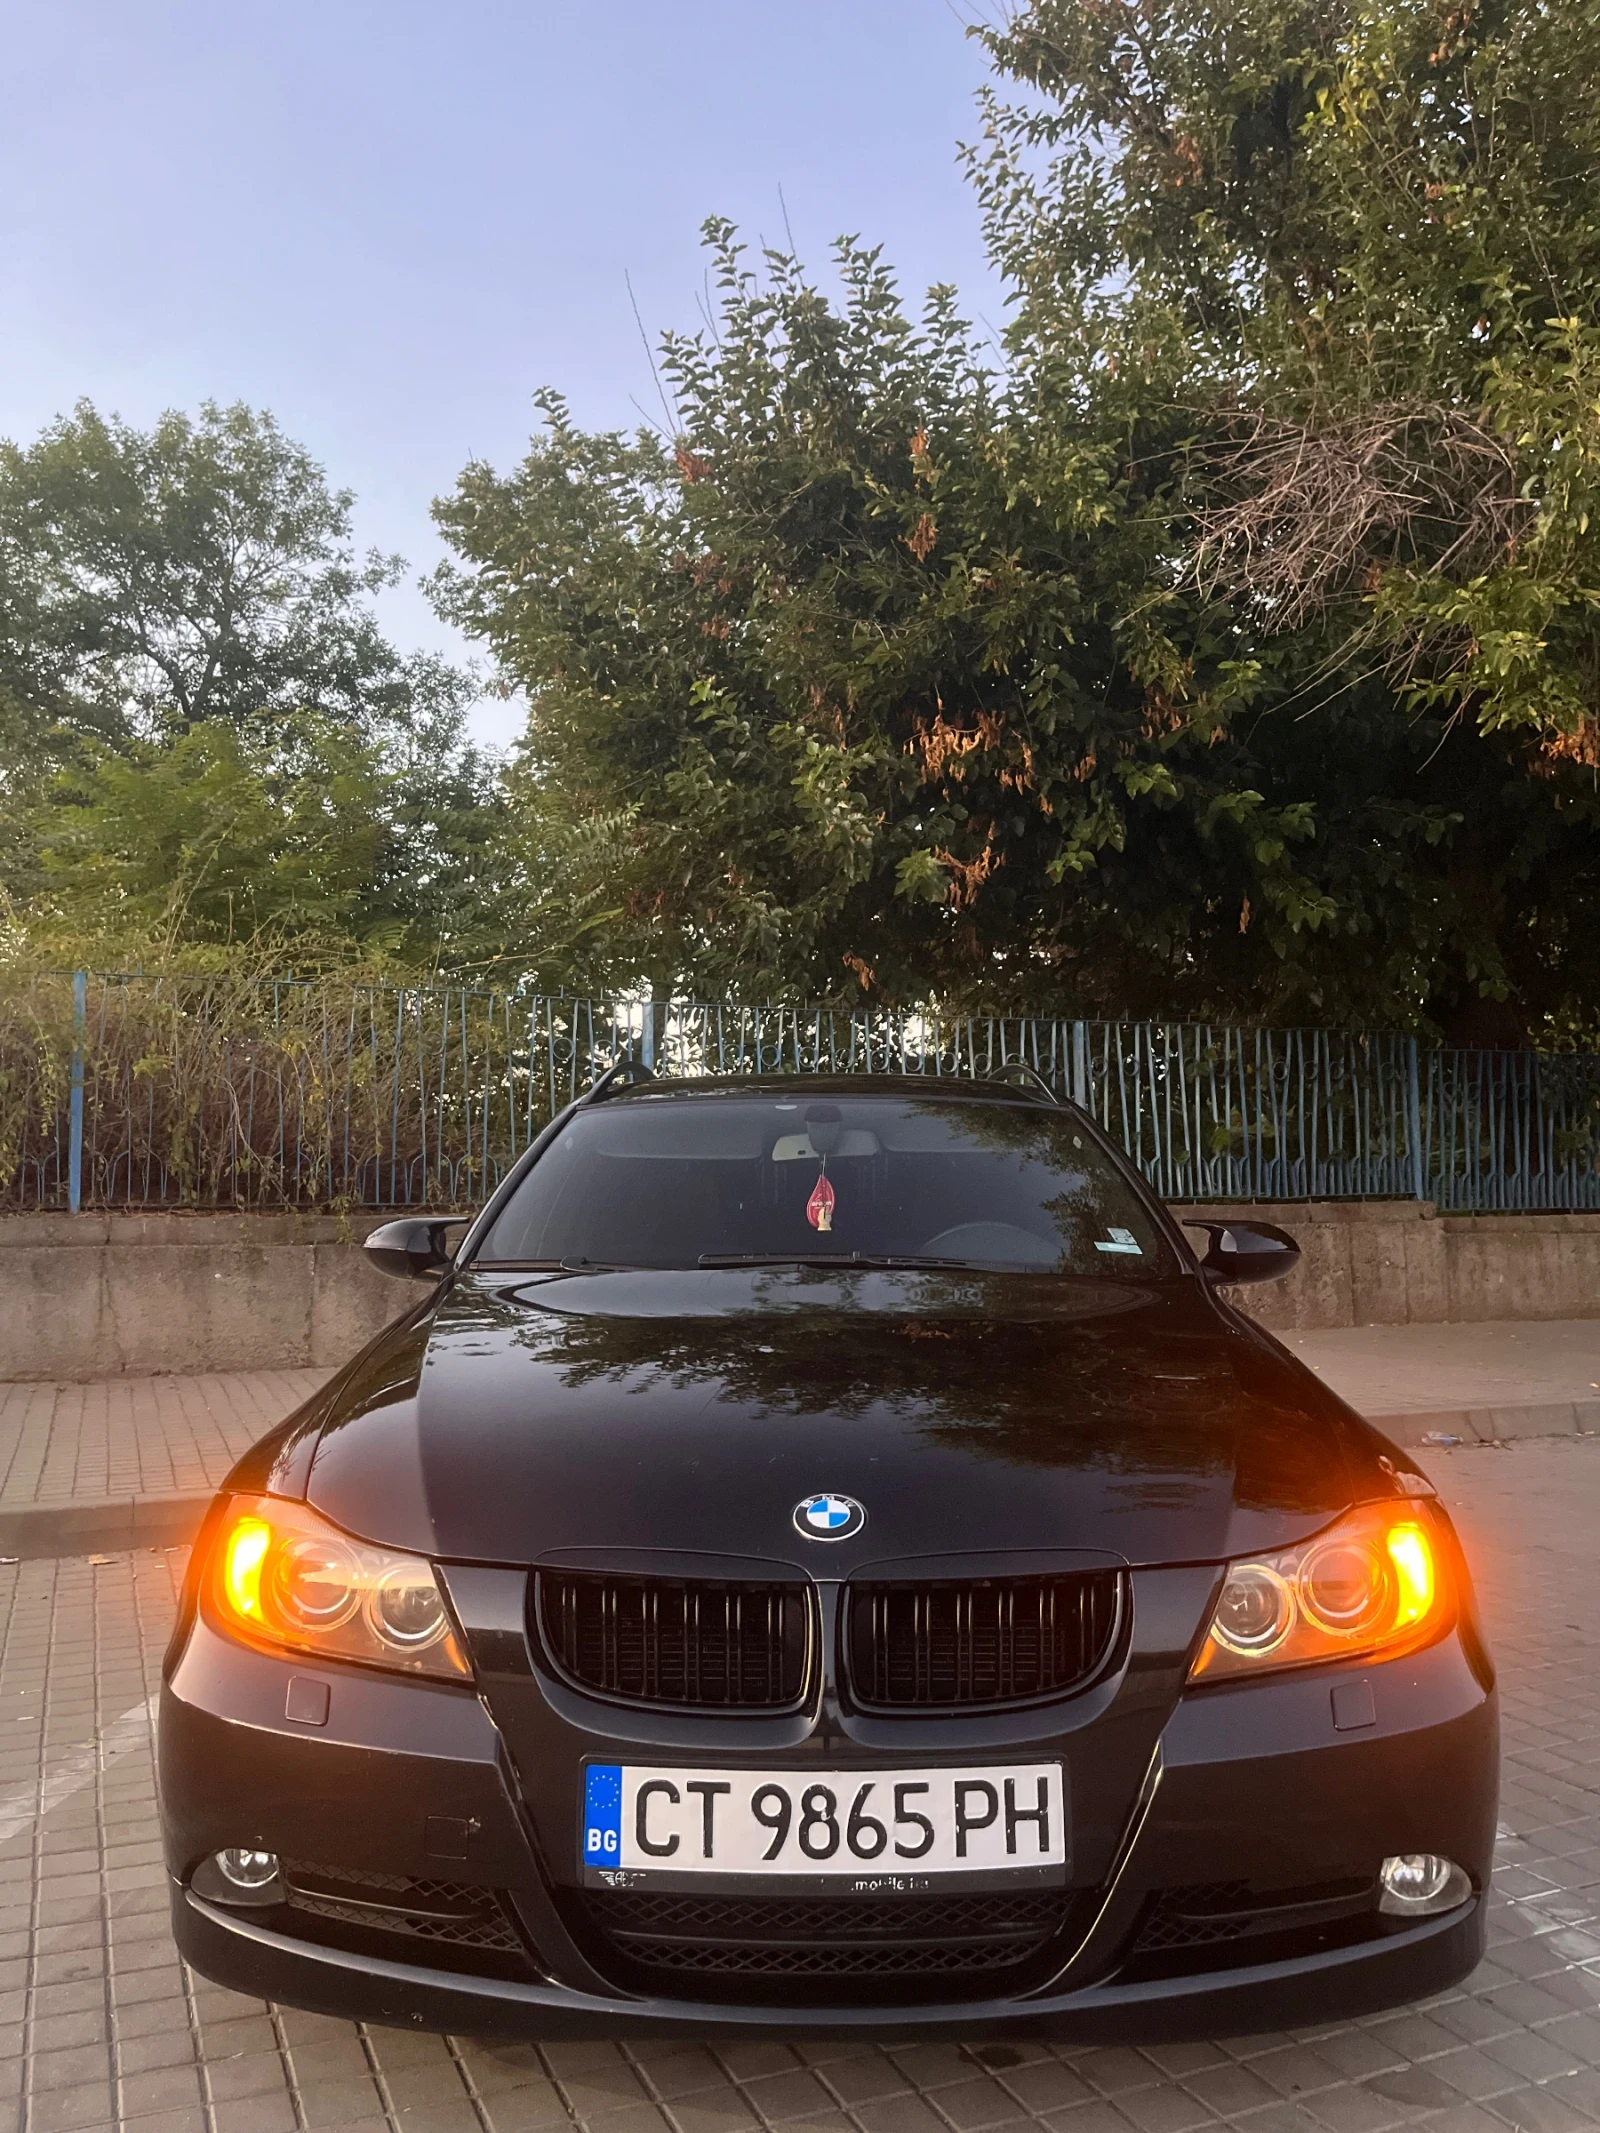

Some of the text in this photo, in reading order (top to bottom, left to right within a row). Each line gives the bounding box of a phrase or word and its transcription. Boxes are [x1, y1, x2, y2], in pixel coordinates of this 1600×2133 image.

[801, 1495, 857, 1508] BMW
[636, 1777, 1050, 1861] CT 9865 PH
[587, 1828, 617, 1852] BG
